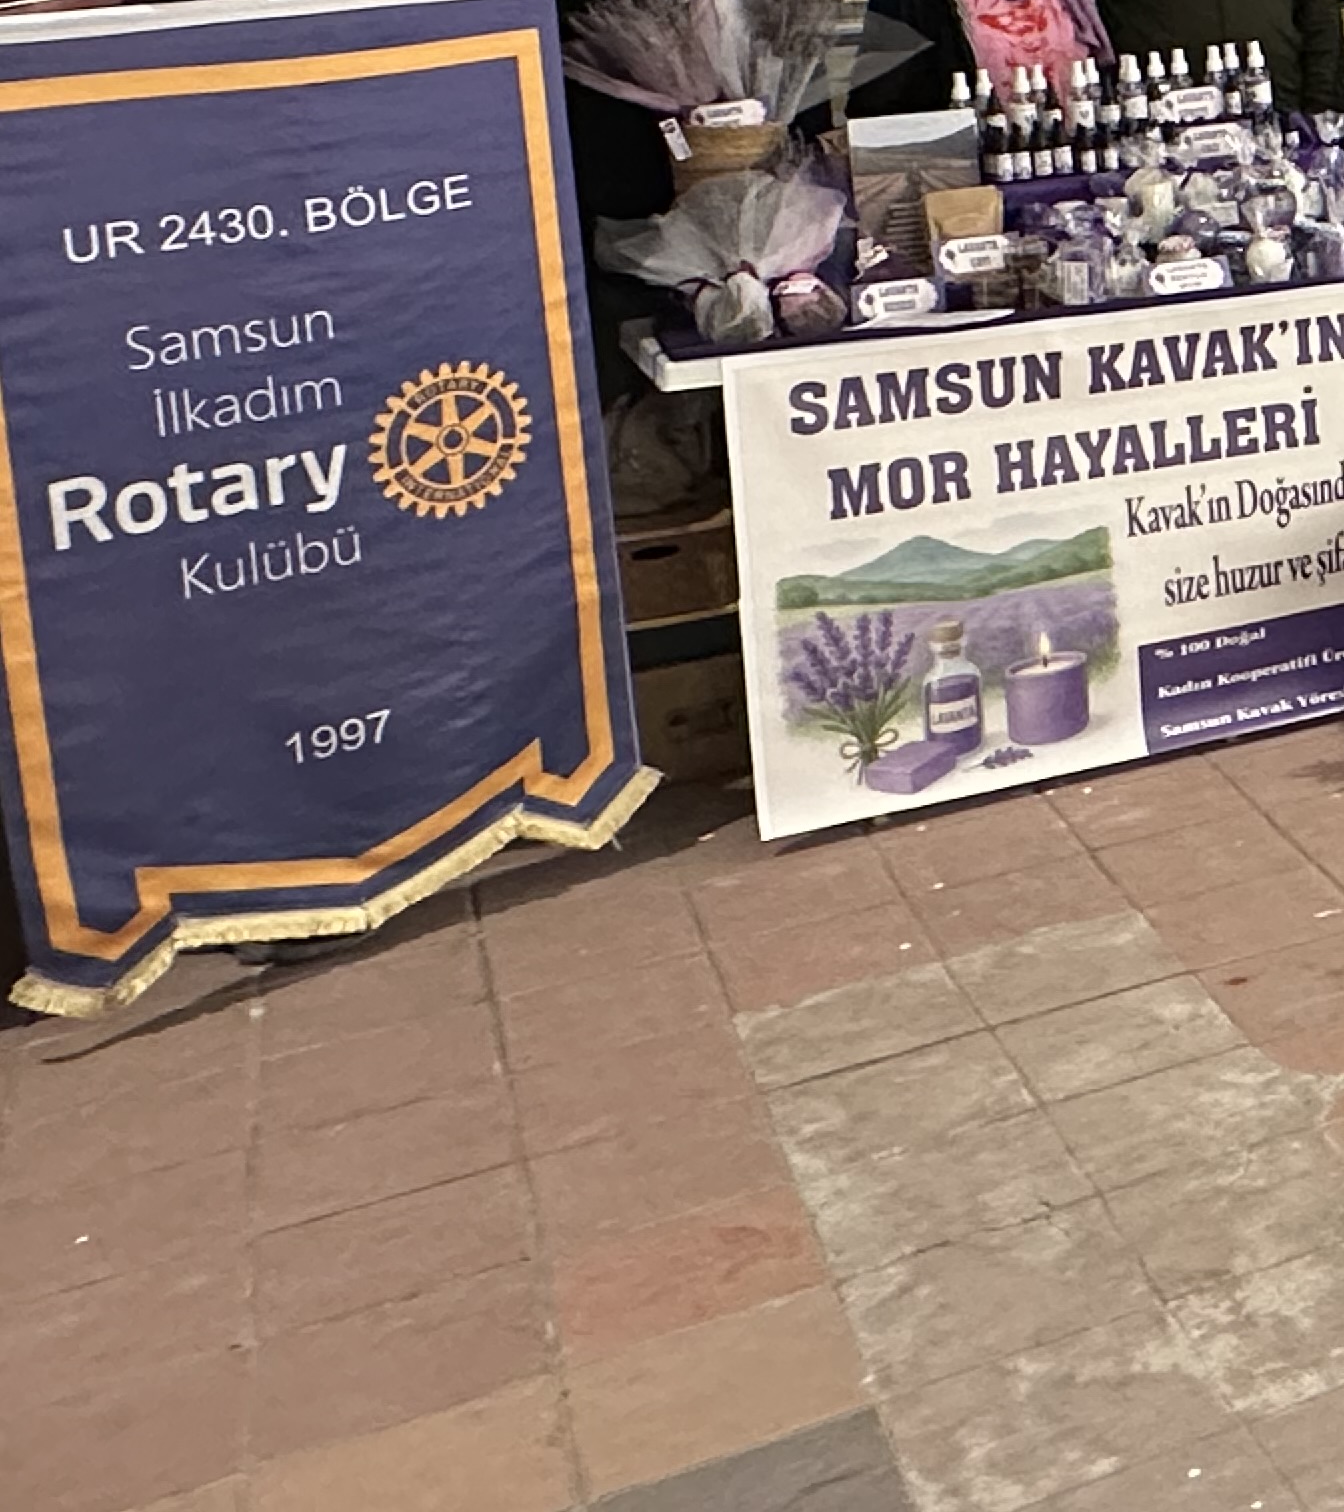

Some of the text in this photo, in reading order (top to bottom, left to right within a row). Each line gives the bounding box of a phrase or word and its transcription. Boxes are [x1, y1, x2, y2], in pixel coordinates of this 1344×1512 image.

[63, 174, 473, 263] UR 2430. BÖLGE
[126, 309, 336, 371] Samsun
[154, 375, 342, 437] İlkadım
[788, 351, 1064, 437] SAMSUN
[827, 386, 1321, 520] MOR HAYALLERİ
[48, 444, 348, 552] Rotary
[1125, 482, 1232, 538] Kavak'ın
[180, 526, 363, 599] Kulübü
[1164, 566, 1210, 607] size
[1213, 554, 1285, 598] huzur
[1287, 553, 1313, 581] ve
[1180, 640, 1211, 656] 100
[1214, 627, 1266, 649] Doğal
[1157, 679, 1213, 699] Kadın
[1217, 652, 1318, 687] Kooperatifi
[285, 708, 392, 764] 1997
[1160, 714, 1232, 738] Samsun
[1236, 698, 1294, 722] Kavak
